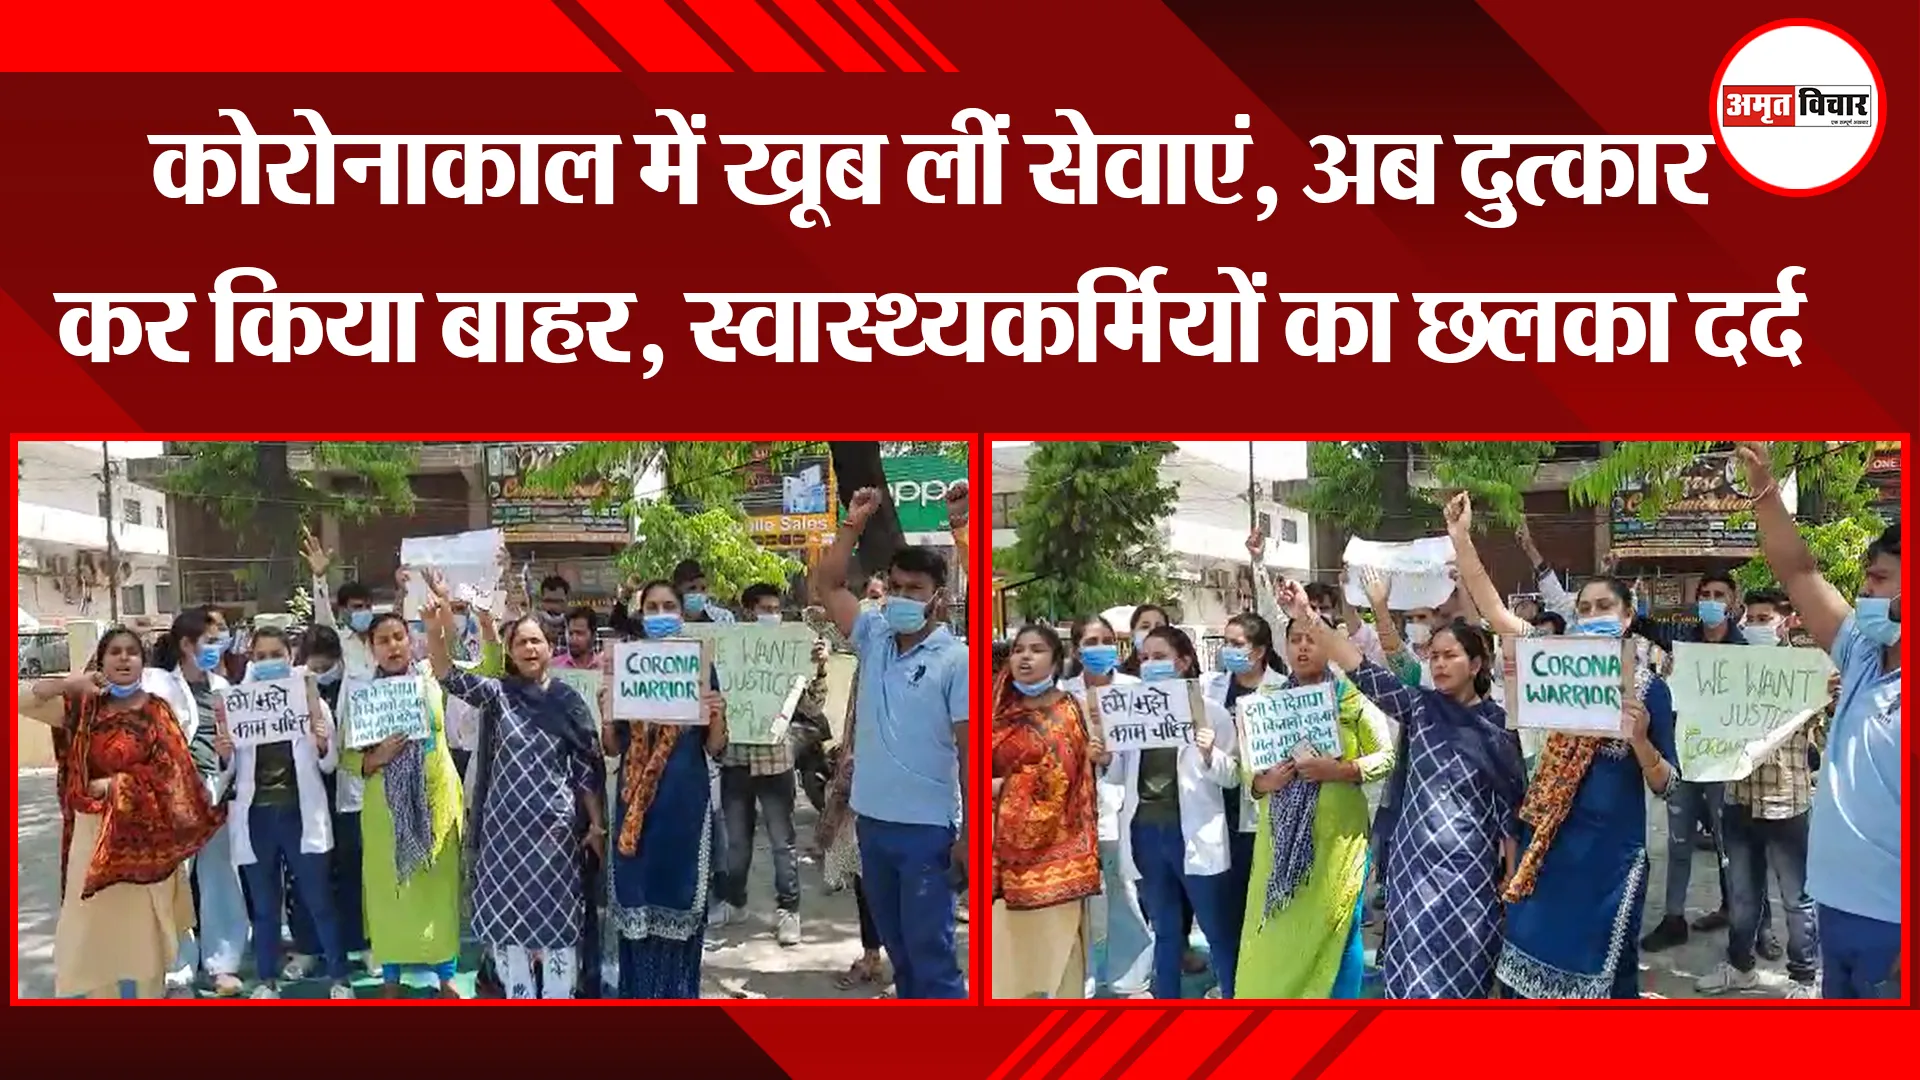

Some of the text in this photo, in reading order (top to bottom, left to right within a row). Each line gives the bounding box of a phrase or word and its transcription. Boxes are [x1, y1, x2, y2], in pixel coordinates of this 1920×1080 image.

[887, 479, 968, 507] pp
[780, 516, 828, 531] Sales
[625, 652, 700, 675] CORONA
[1531, 650, 1622, 678] CORONA
[620, 680, 700, 702] WARRIOR
[1695, 658, 1819, 703] WE WANT
[1526, 683, 1622, 710] WARRIOR
[233, 719, 269, 739] काम
[1109, 723, 1147, 743] काम
